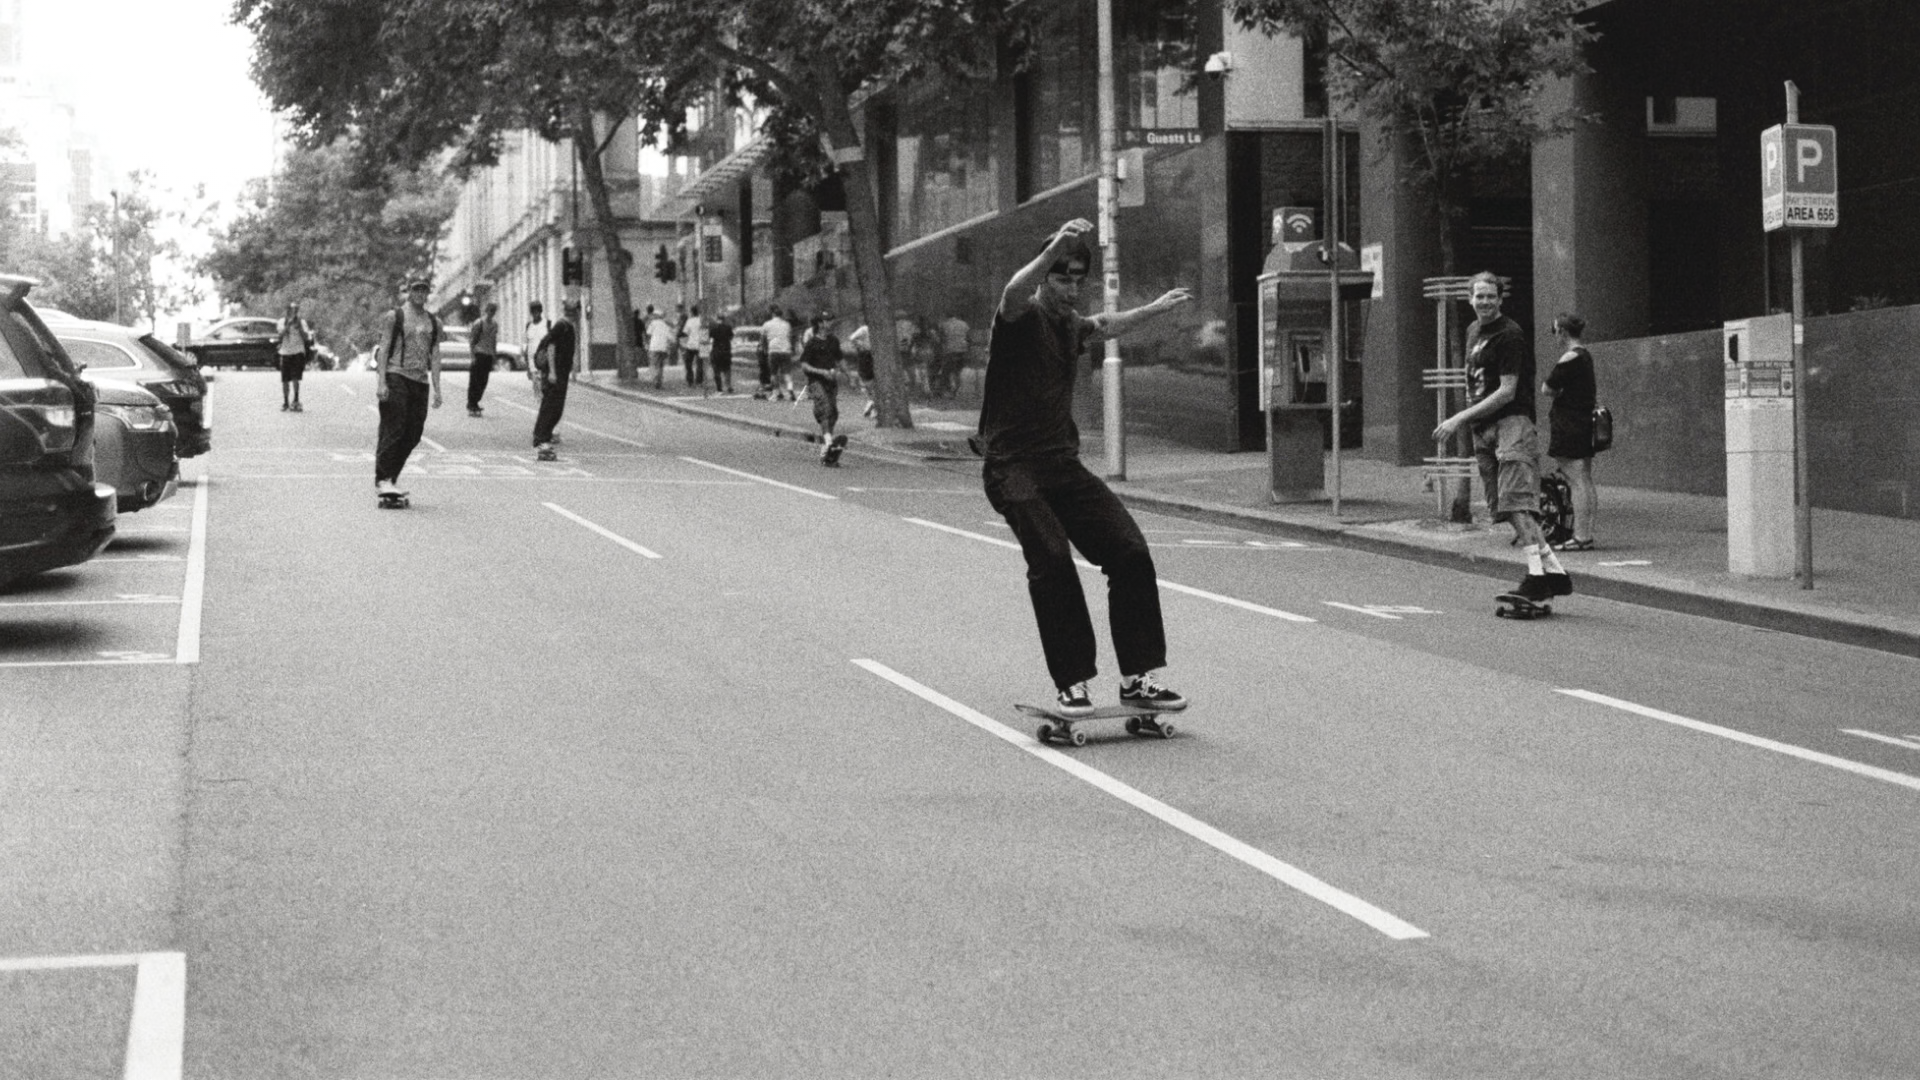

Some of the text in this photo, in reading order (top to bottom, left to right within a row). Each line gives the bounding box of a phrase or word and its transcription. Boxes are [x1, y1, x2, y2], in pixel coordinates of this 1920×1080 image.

[1146, 132, 1185, 145] Guests
[1766, 141, 1777, 187] P
[1797, 138, 1823, 183] P
[1787, 206, 1835, 221] AREA 656
